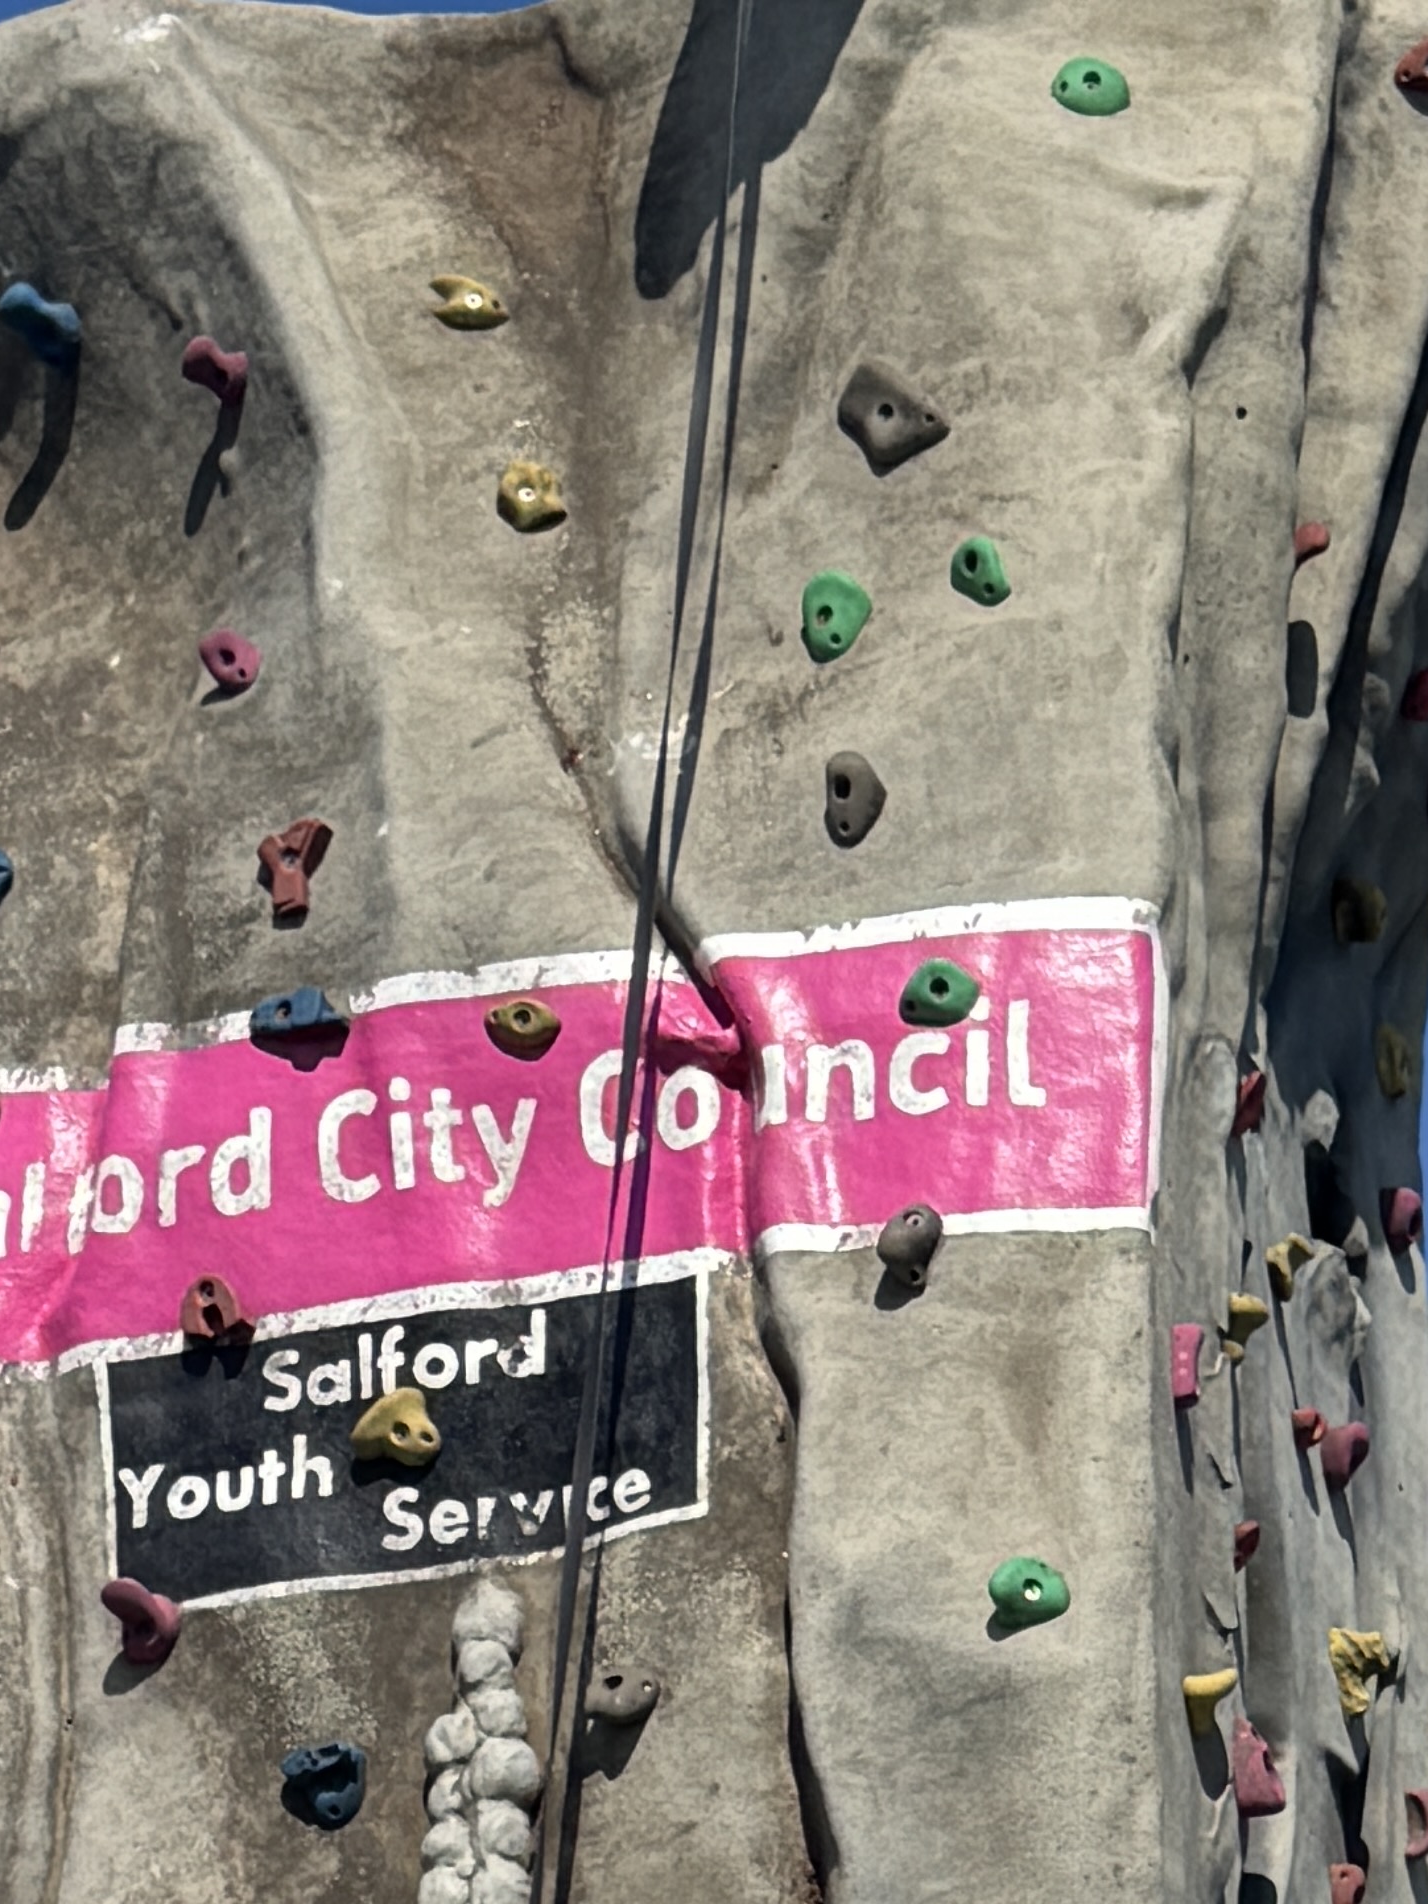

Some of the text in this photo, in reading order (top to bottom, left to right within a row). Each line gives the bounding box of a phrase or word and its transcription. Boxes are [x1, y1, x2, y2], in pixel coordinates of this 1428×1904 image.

[317, 1076, 537, 1208] City
[261, 1308, 547, 1413] Salford
[118, 1434, 334, 1529] Youth
